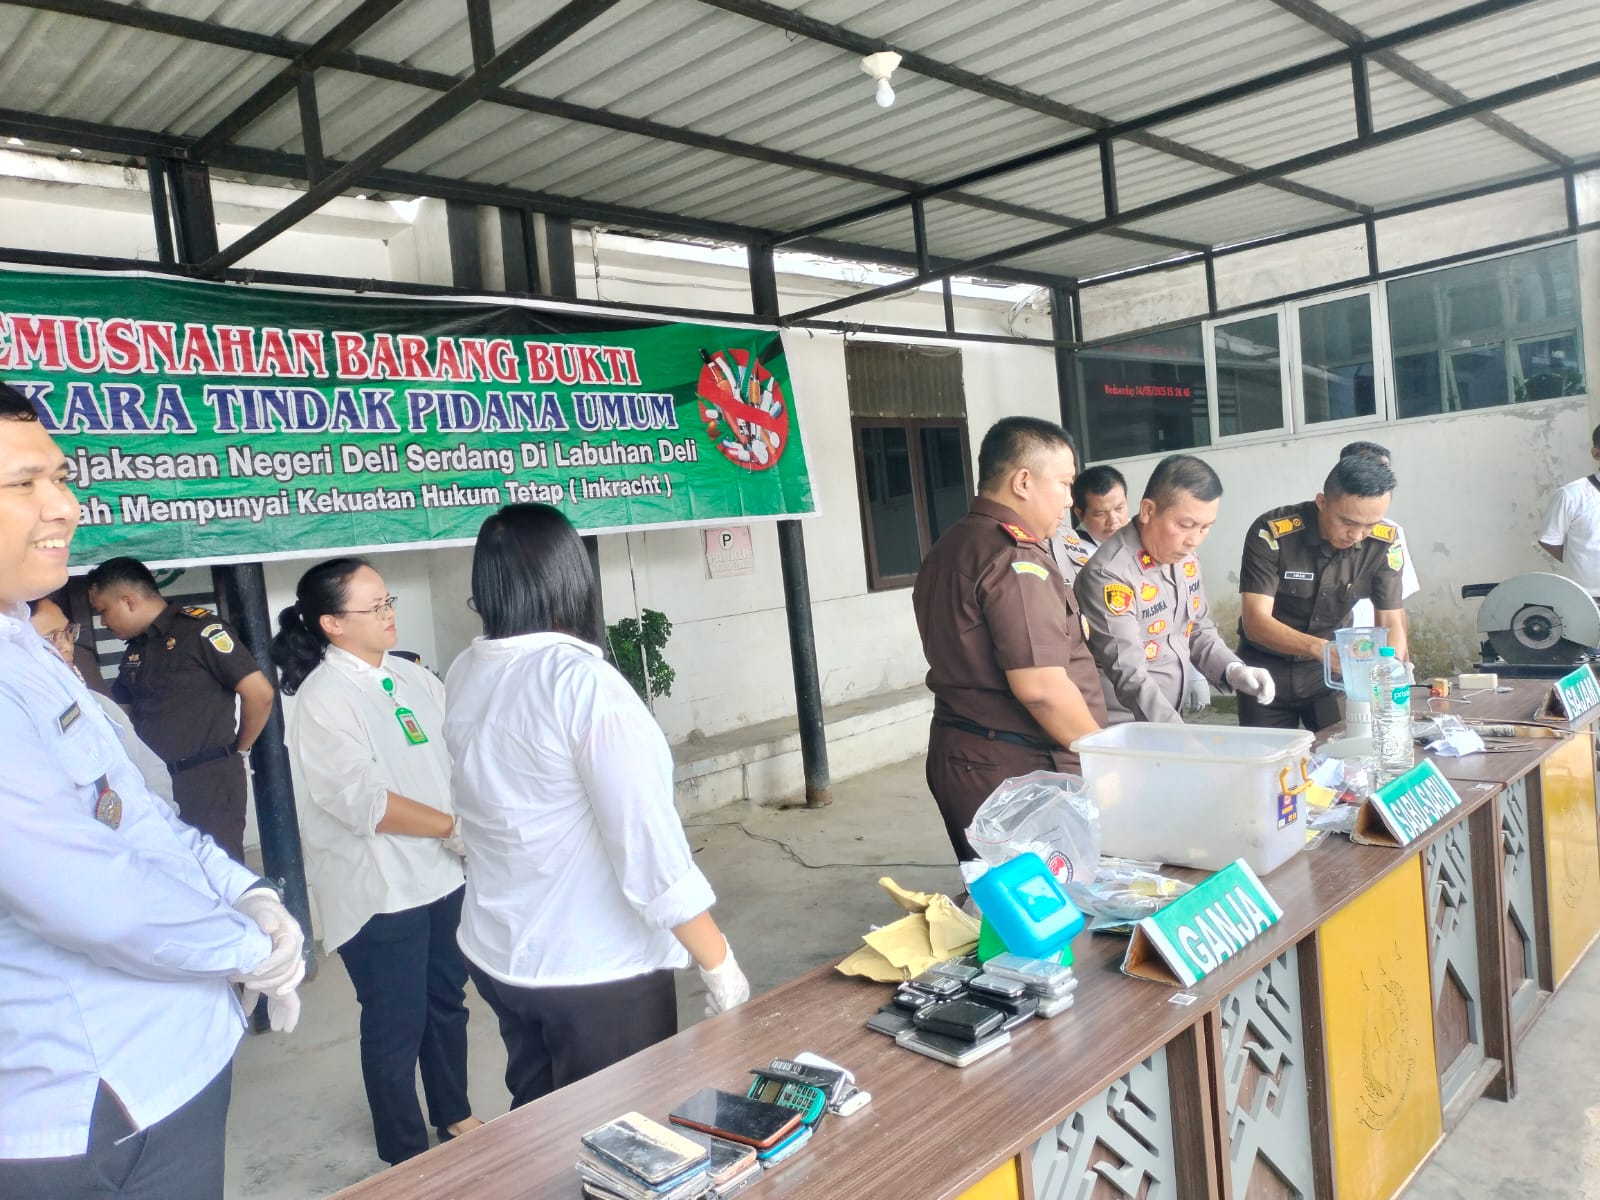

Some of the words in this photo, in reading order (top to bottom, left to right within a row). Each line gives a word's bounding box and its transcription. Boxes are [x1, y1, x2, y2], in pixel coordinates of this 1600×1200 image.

[332, 331, 520, 384] BARANG
[524, 341, 642, 386] BUKTI
[203, 384, 401, 433] TINDAK
[405, 389, 570, 434] PIDANA
[573, 391, 678, 431] UMUM
[227, 444, 334, 486] Negeri
[340, 443, 399, 475] Deli
[406, 440, 515, 474] Serdang
[520, 441, 548, 469] Di
[555, 440, 654, 469] Labuhan
[659, 438, 698, 464] Deli
[122, 489, 290, 526] Mempunyai
[297, 488, 416, 514] Kekuatan
[421, 483, 500, 509] Hukum
[504, 480, 563, 507] Tetap
[580, 474, 660, 499] Inkracht
[722, 533, 732, 547] P
[1177, 885, 1272, 975] GANJA
